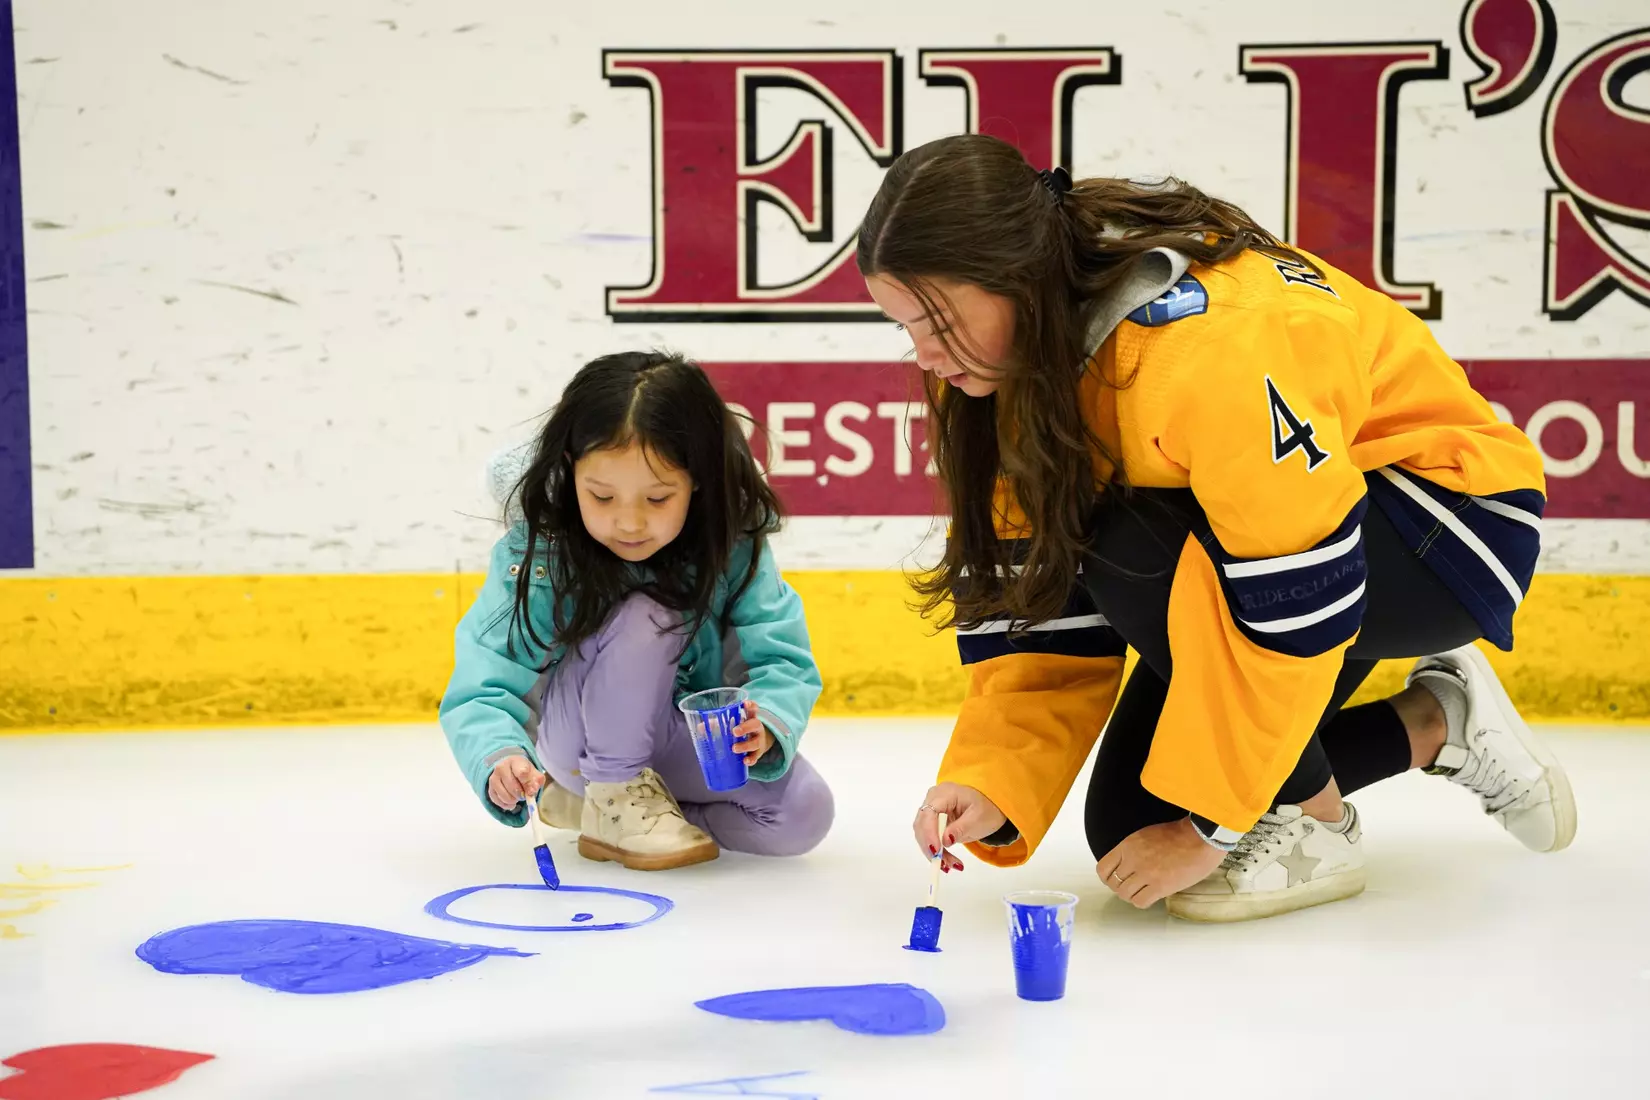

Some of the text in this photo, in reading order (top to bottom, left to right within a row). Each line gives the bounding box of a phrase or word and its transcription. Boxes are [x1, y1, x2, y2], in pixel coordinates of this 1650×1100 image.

[724, 400, 1650, 479] EST OU
[1264, 374, 1332, 474] 4
